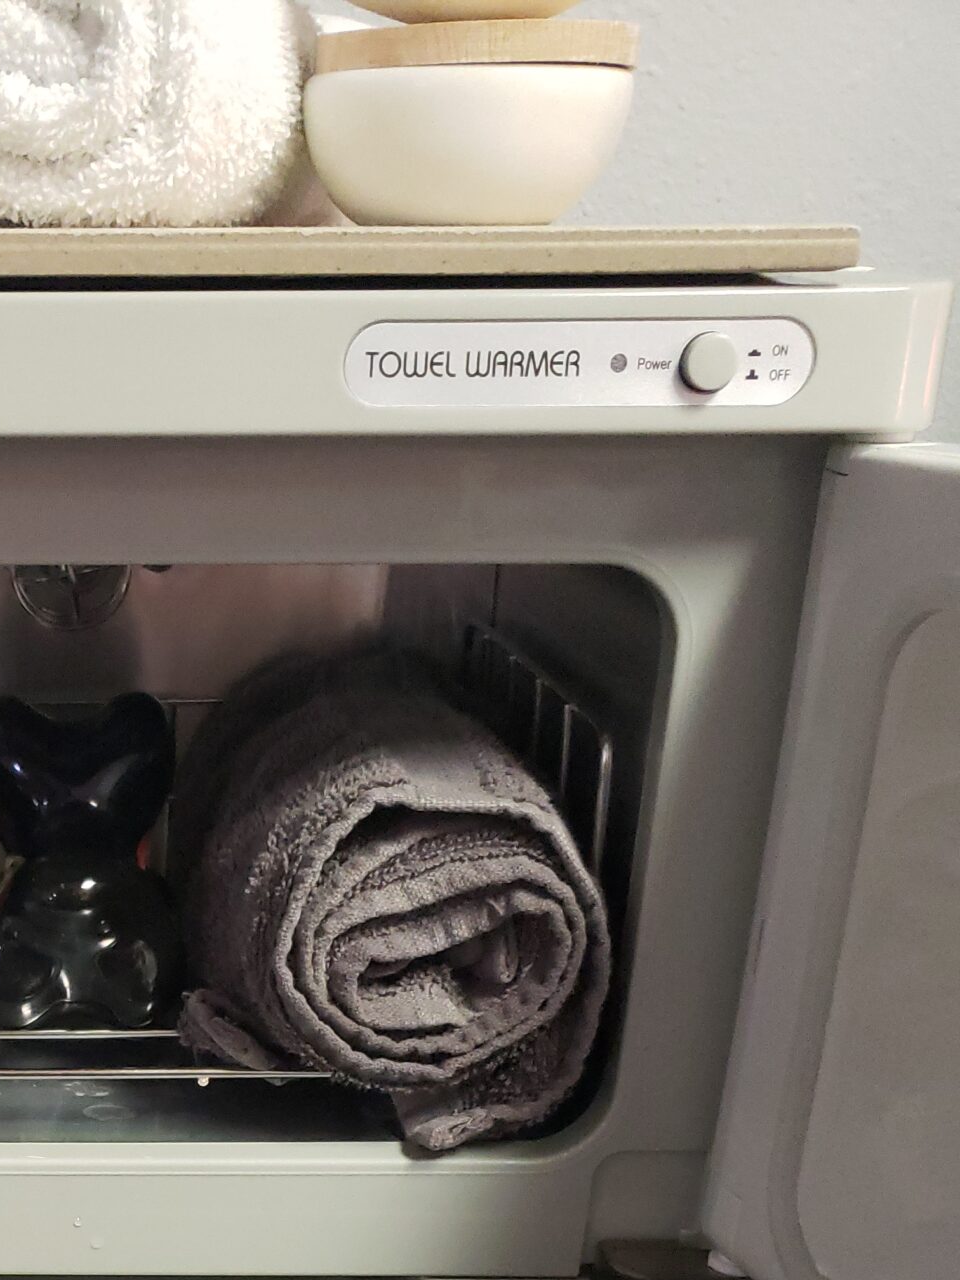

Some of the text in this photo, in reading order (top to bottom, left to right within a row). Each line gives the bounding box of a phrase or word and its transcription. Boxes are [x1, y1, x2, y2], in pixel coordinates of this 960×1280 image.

[771, 344, 789, 357] ON
[365, 349, 581, 378] TOWEL WARMER
[636, 357, 672, 370] Power
[768, 369, 791, 381] OFF
